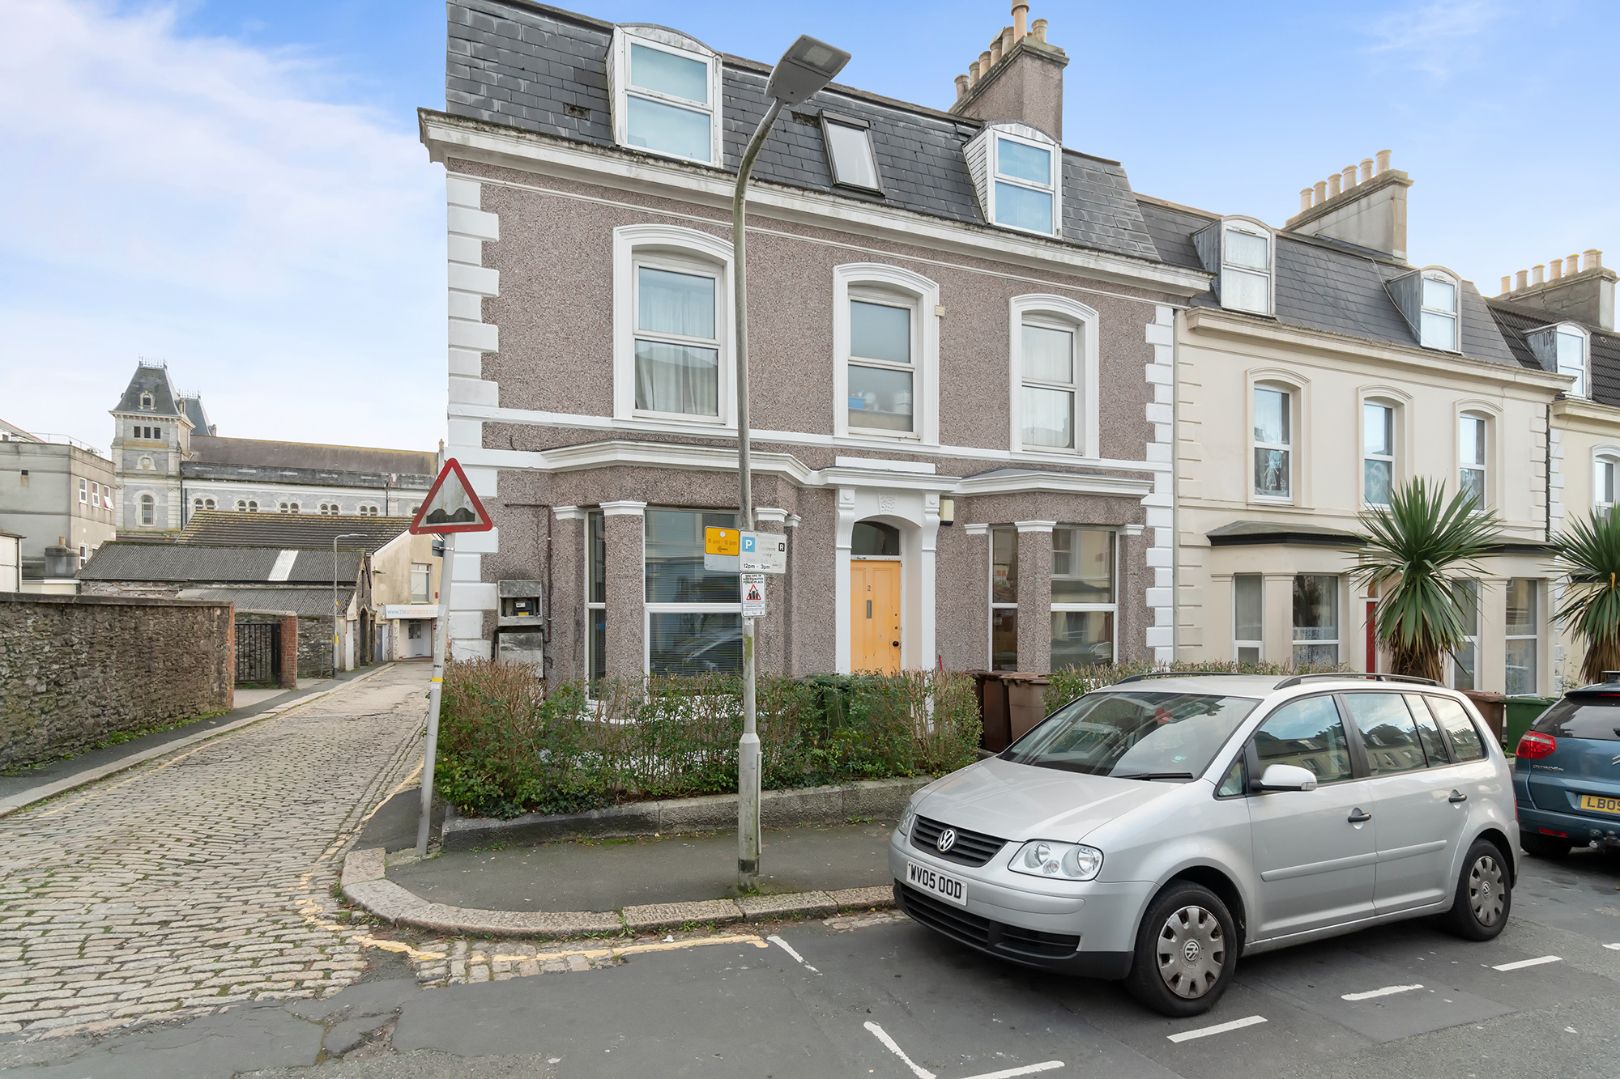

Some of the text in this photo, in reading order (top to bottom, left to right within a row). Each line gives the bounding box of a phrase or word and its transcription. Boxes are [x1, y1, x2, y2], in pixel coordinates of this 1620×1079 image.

[745, 539, 753, 550] P
[910, 864, 962, 899] WV05 OOD
